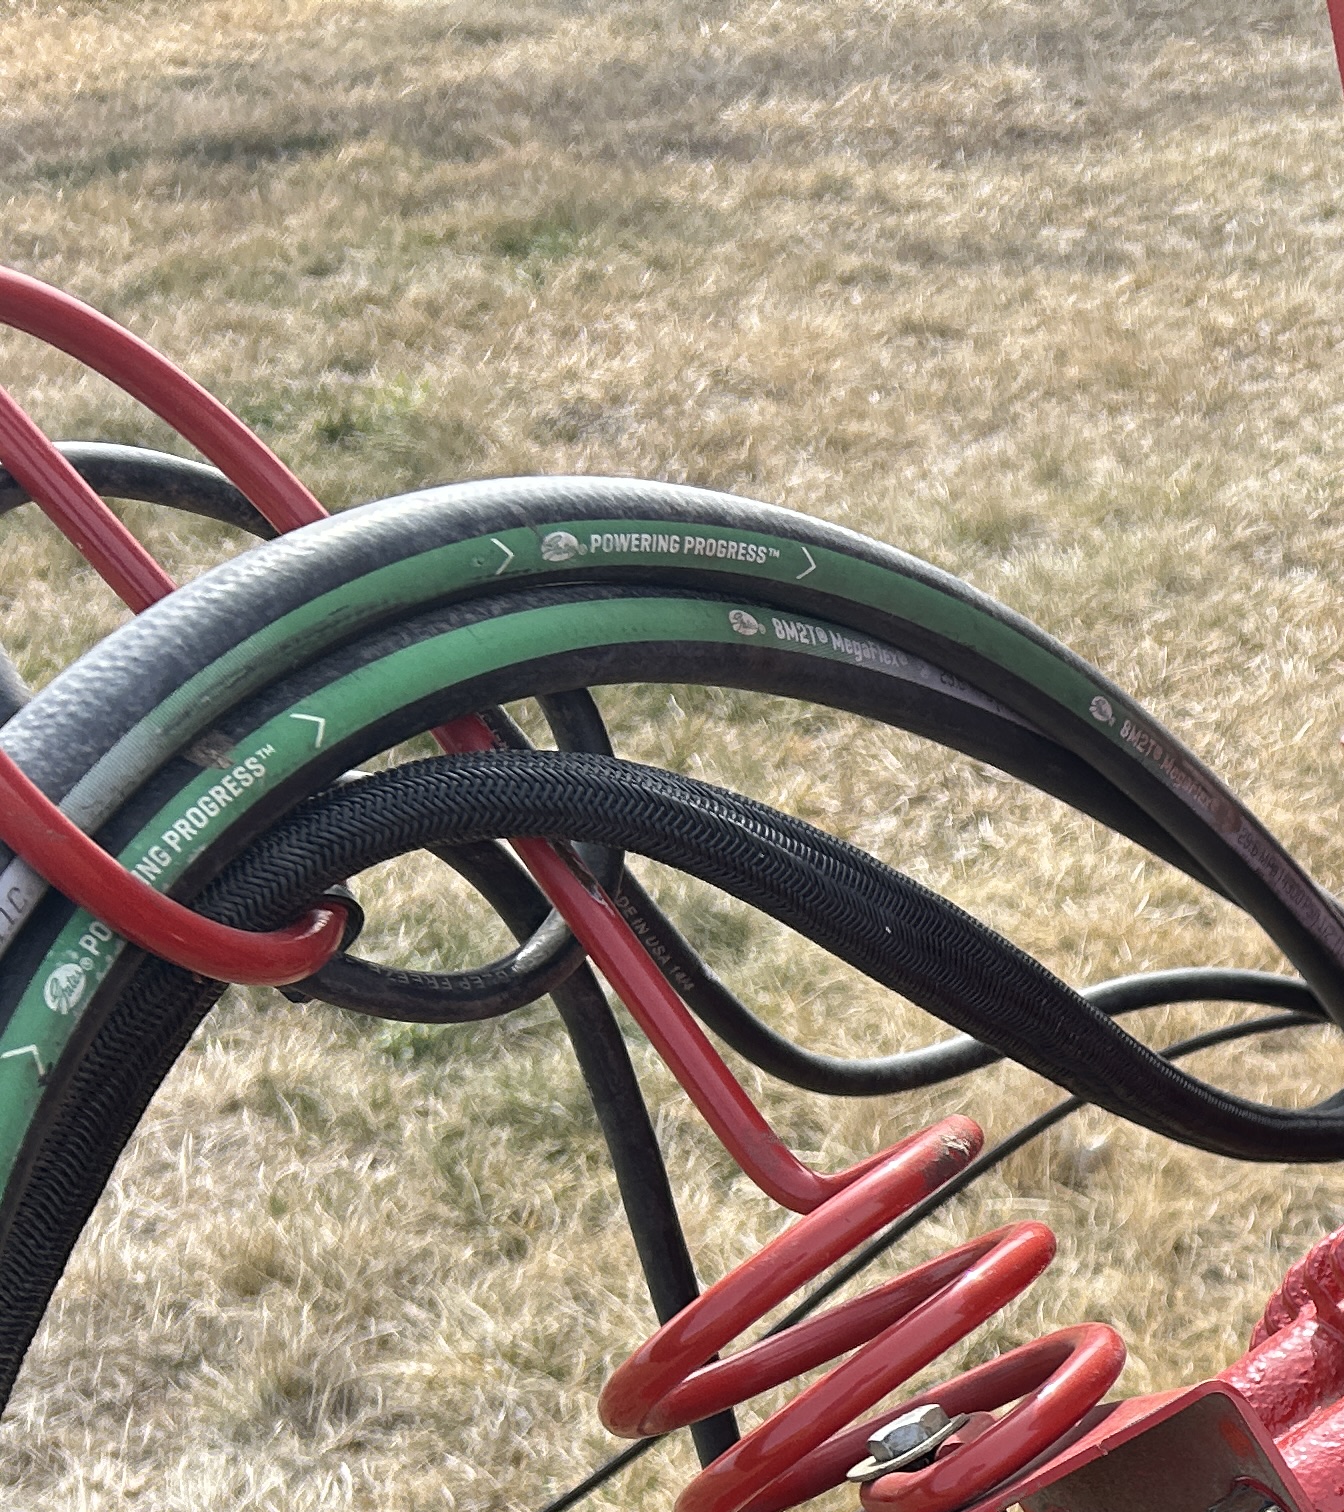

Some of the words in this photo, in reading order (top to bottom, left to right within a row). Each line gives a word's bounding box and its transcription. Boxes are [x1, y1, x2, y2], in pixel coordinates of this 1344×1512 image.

[590, 533, 679, 554] POWERING
[633, 917, 649, 934] IN
[645, 935, 671, 966] USA
